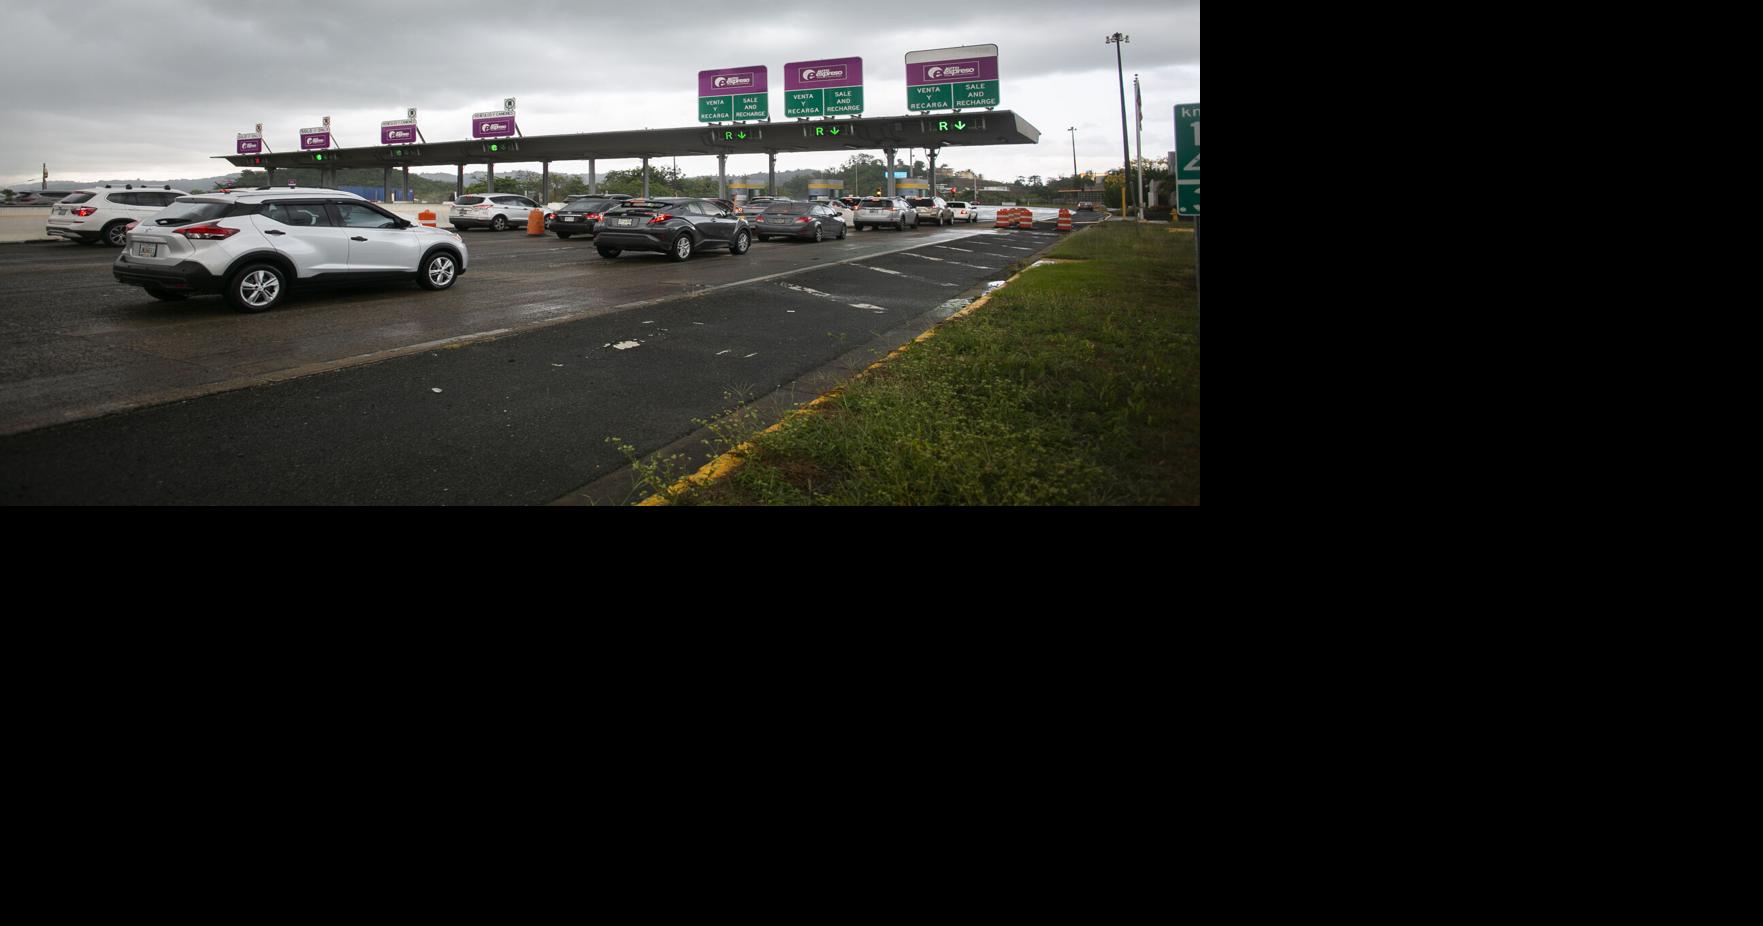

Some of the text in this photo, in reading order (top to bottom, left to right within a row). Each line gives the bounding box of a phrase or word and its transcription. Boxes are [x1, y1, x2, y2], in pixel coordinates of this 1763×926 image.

[957, 98, 995, 106] RECHARGE
[939, 122, 948, 130] R
[816, 127, 824, 135] R
